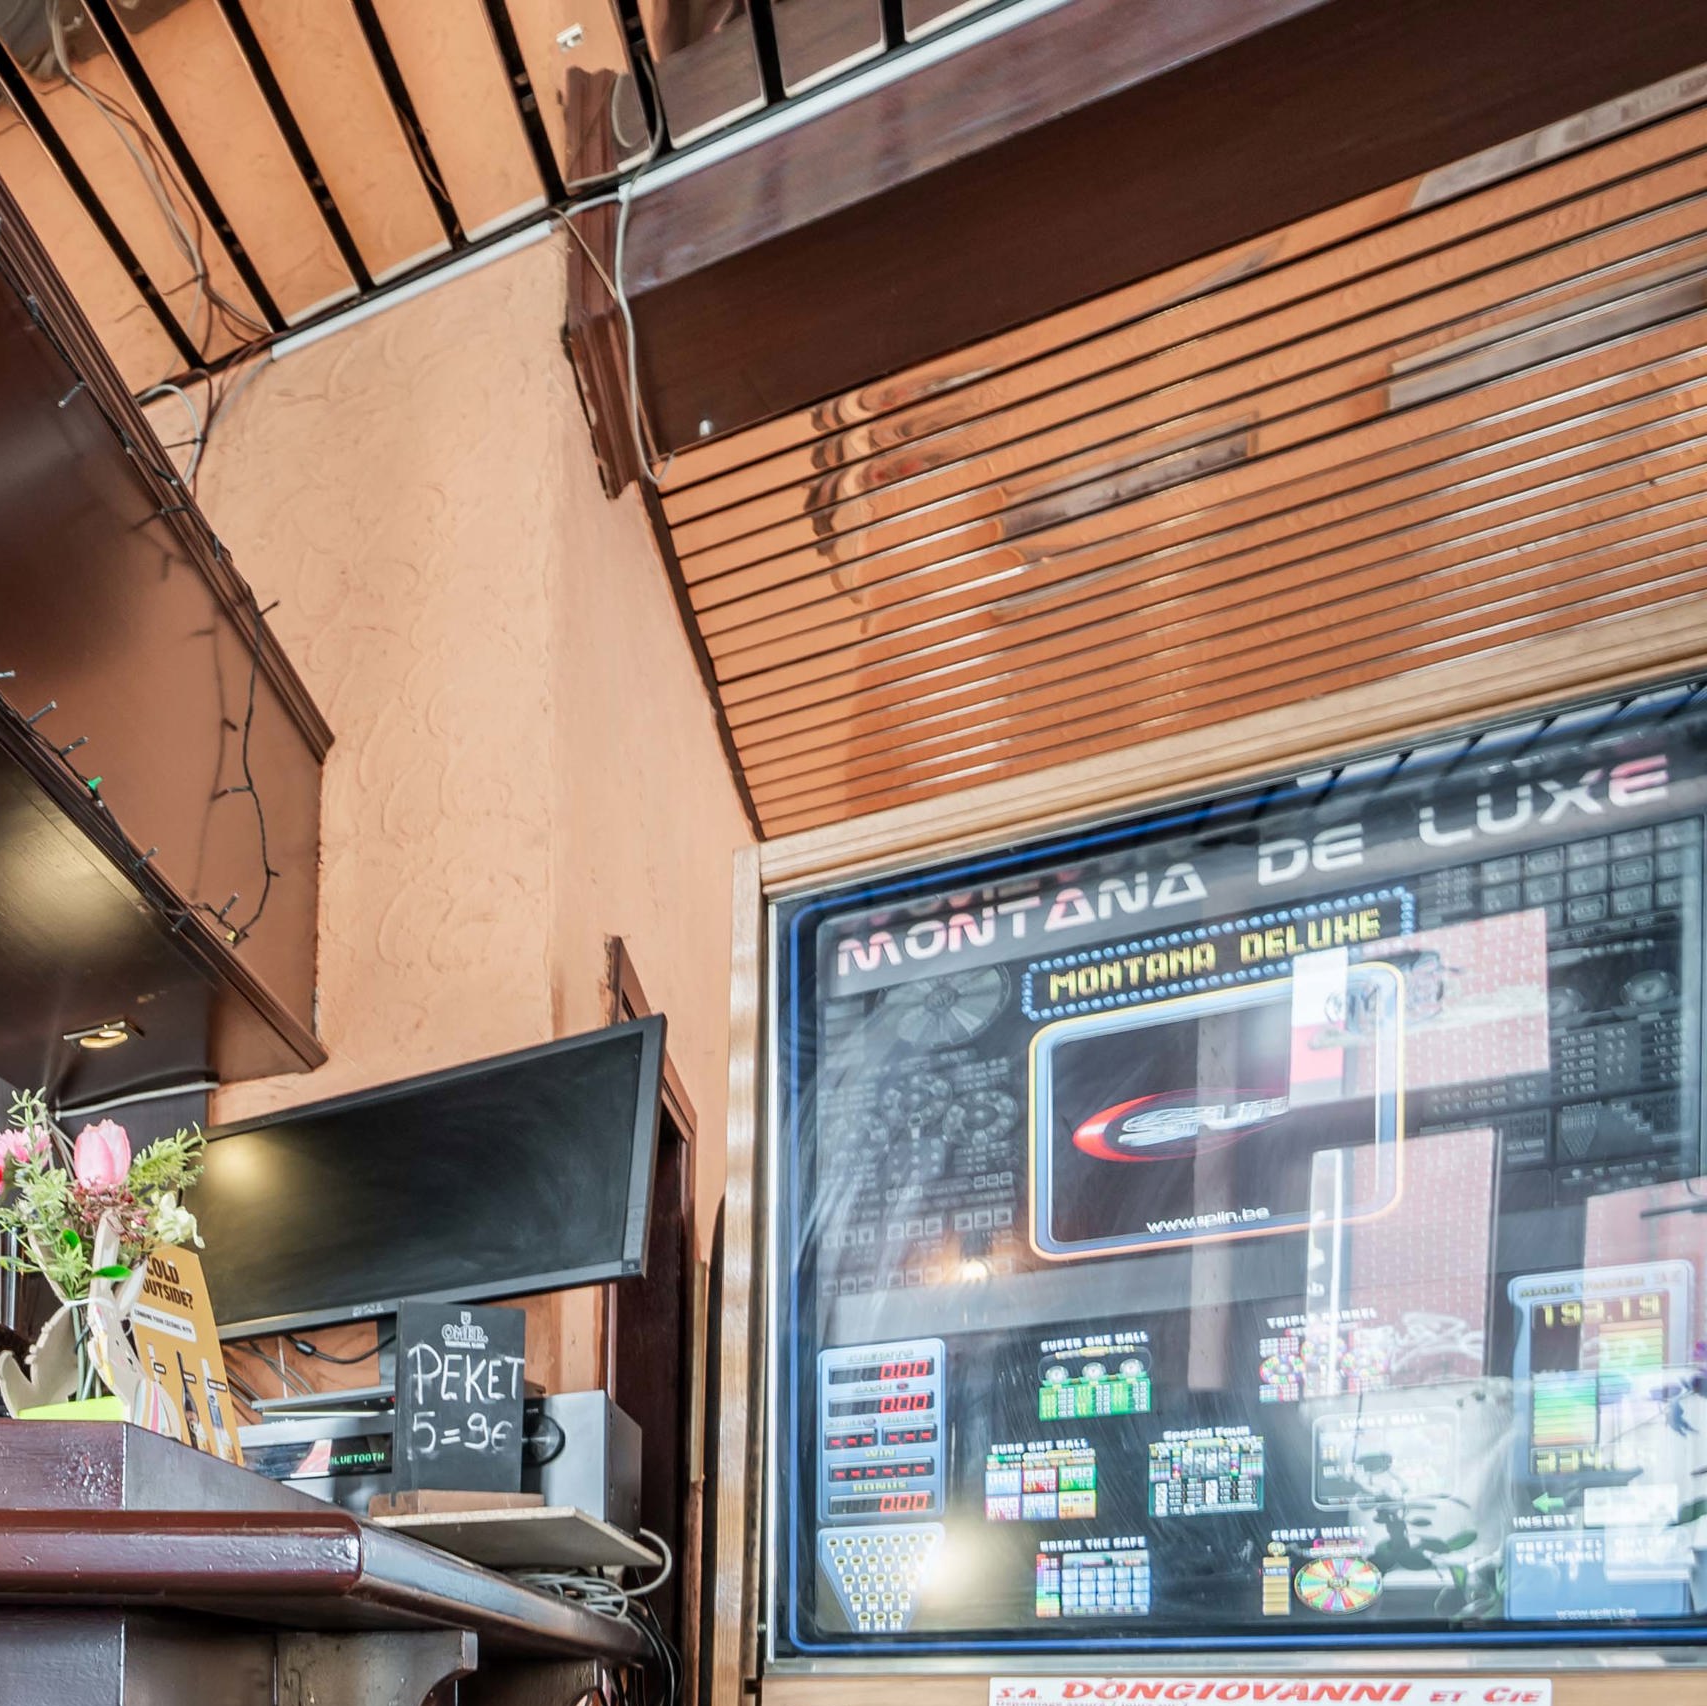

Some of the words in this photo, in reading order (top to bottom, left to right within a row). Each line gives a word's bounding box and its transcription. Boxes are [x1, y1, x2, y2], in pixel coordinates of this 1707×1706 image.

[836, 863, 1208, 977] MONTANA
[1255, 823, 1364, 888] DE
[1418, 755, 1672, 850] LUXE
[1048, 943, 1217, 1001] MONTANA
[1239, 906, 1382, 965] DELUXE
[1085, 1333, 1112, 1347] ONE
[408, 1342, 526, 1405] PEKET
[1027, 1440, 1053, 1452] ONE
[1513, 1513, 1579, 1530] INSERT
[1320, 1525, 1368, 1540] WHEEL
[1085, 1536, 1111, 1550] THE
[1060, 1680, 1413, 1702] DONGIOVANNI
